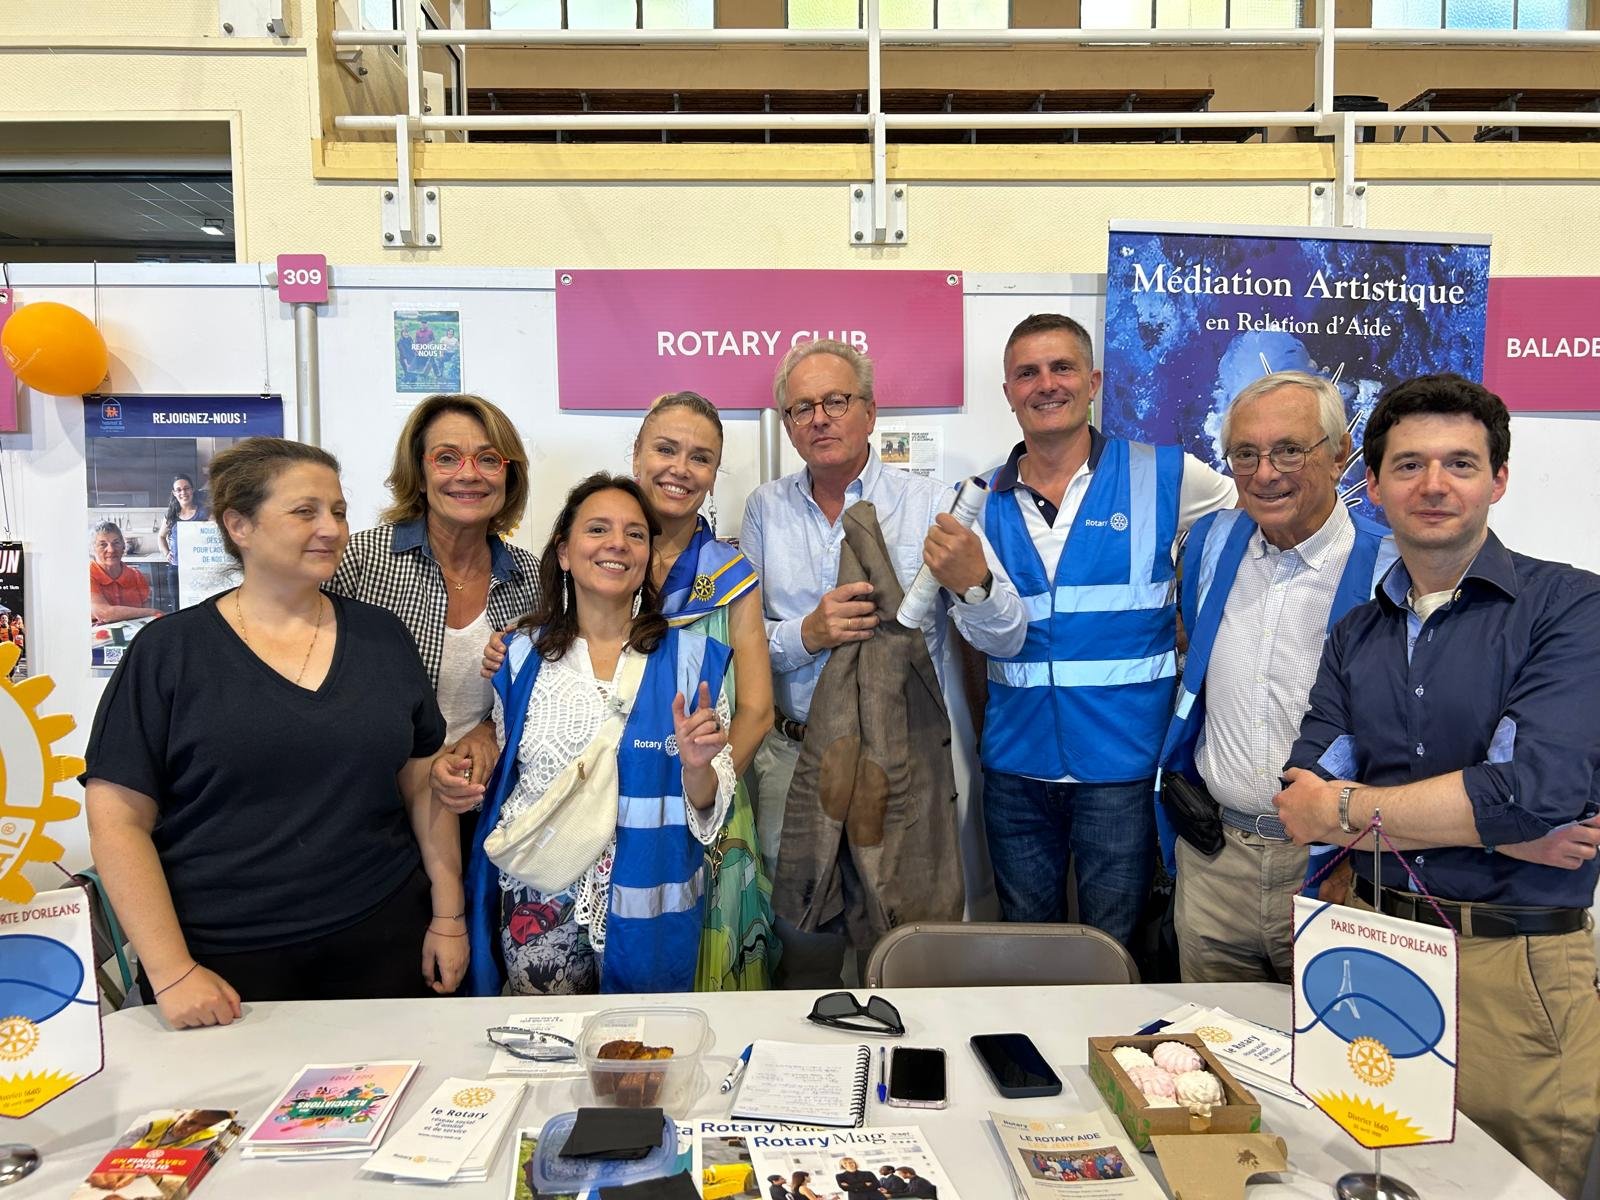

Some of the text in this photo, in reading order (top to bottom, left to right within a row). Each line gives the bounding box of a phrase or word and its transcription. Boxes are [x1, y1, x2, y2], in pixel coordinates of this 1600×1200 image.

[283, 269, 322, 285] 309
[1131, 263, 1465, 310] Médiation Artistique
[1205, 312, 1392, 337] en Relation d'Aide
[657, 330, 782, 356] ROTARY
[152, 412, 241, 424] REJOIGNEZ-NOUS
[633, 739, 663, 750] Rotary
[22, 903, 81, 922] D'ORLEANS
[1331, 918, 1448, 957] PARIS PORTE D'ORLEANS
[297, 1099, 368, 1109] ASSOCIATIONS
[310, 1107, 345, 1116] GUIDE
[431, 1106, 489, 1120] le Rotary
[1347, 1111, 1372, 1126] District
[701, 1121, 776, 1134] Rotary
[754, 1134, 830, 1148] Rotary
[832, 1131, 887, 1145] Mag
[1034, 1135, 1074, 1143] ROTARY
